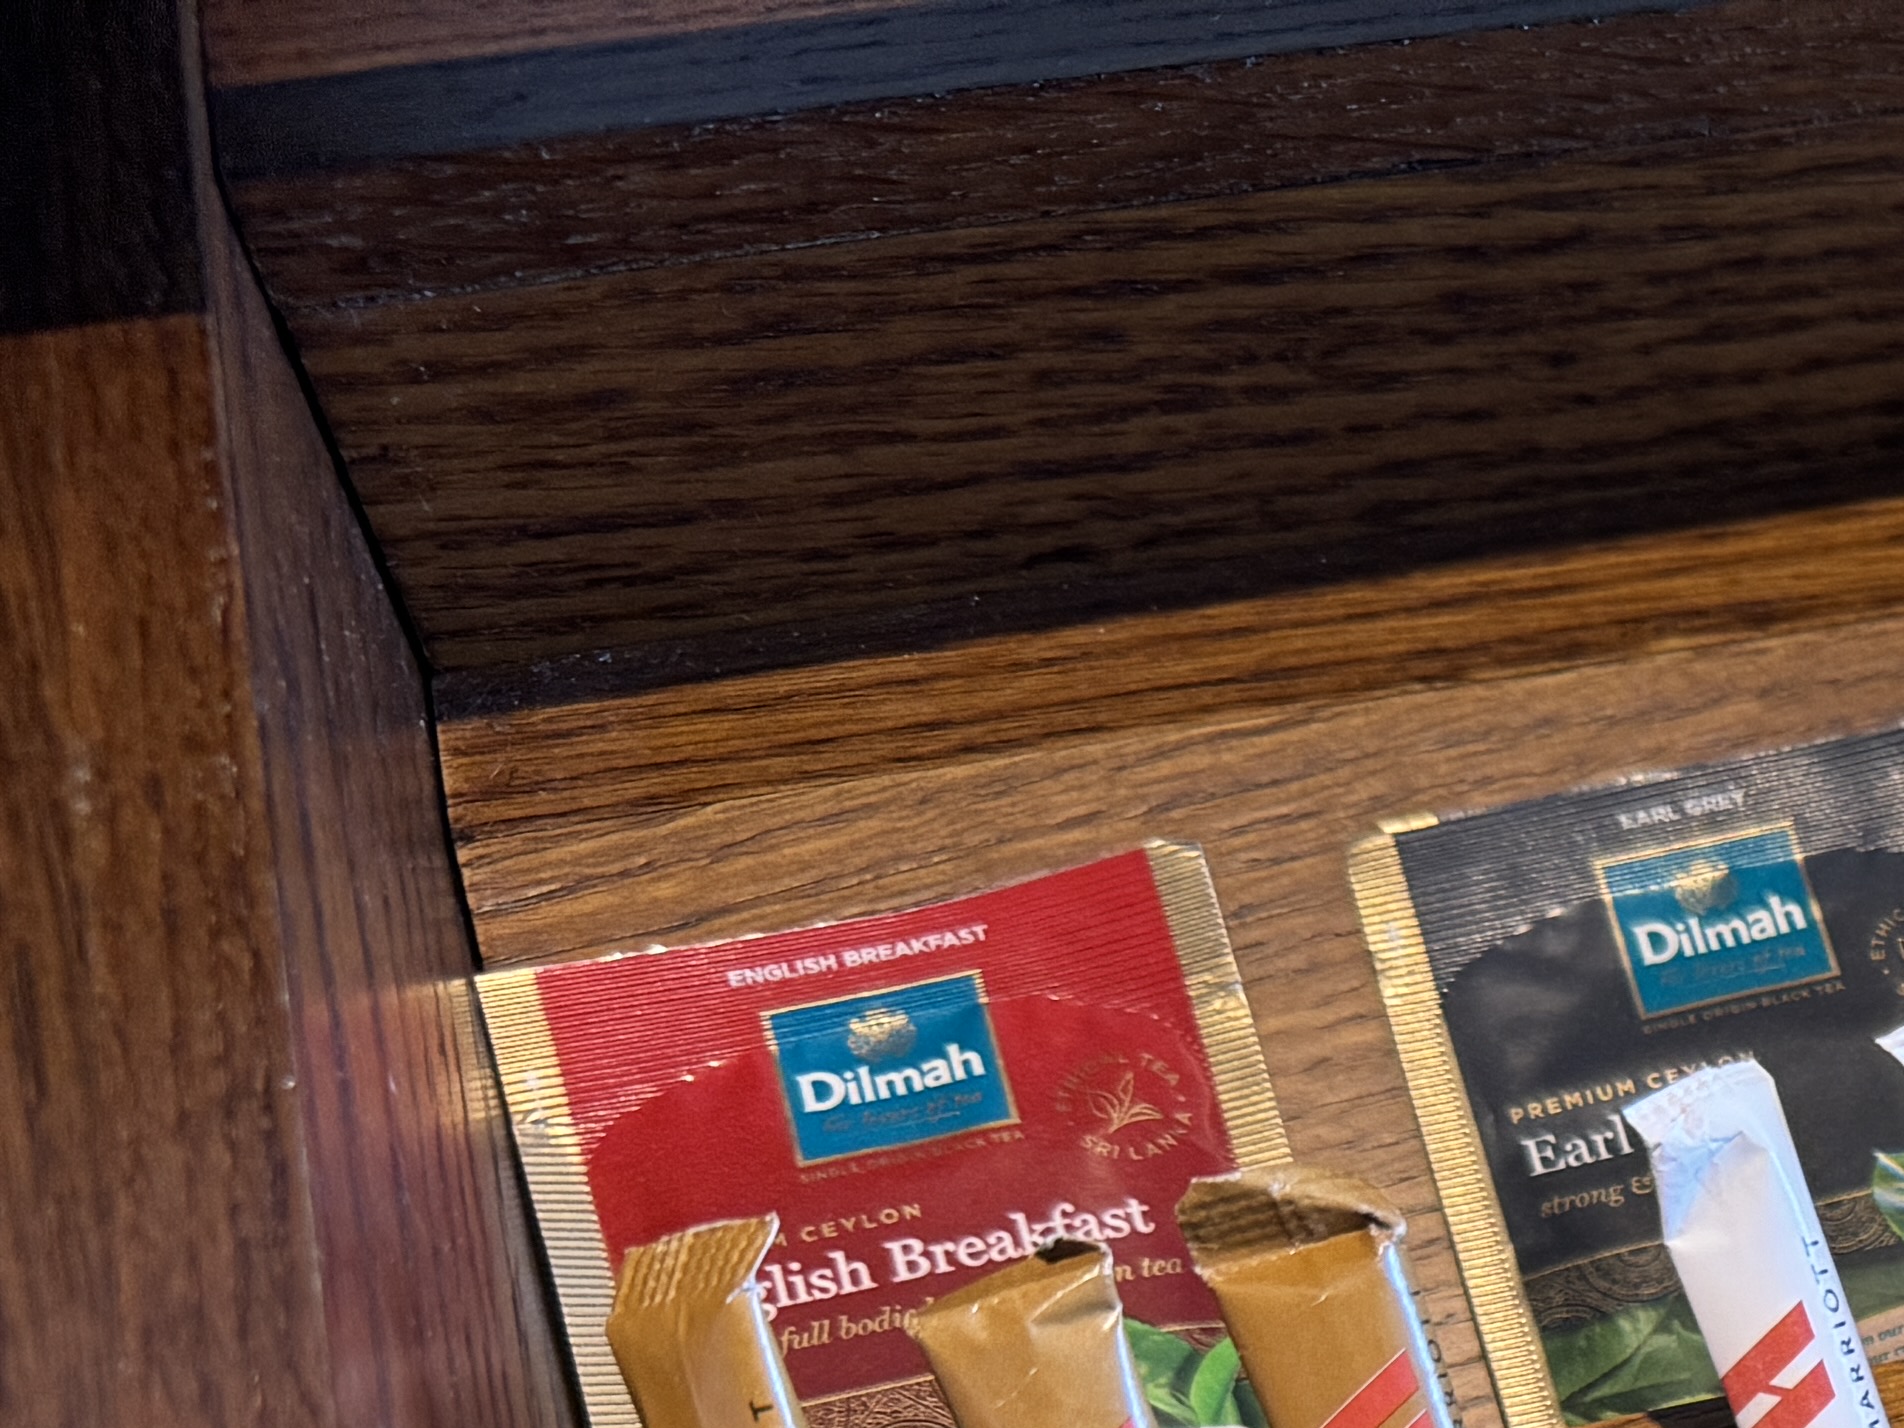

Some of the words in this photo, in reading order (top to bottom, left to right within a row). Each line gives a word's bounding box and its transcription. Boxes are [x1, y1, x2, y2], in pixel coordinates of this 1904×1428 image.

[1617, 801, 1680, 831] EARL
[1684, 791, 1746, 819] GREY
[1634, 894, 1808, 967] Dilmah
[726, 953, 839, 989] ENGLISH
[843, 924, 989, 969] BREAKFAST
[1815, 979, 1846, 998] TEA
[795, 1043, 986, 1114] Dilmah
[1140, 1052, 1181, 1088] TEA
[1509, 1078, 1636, 1125] PREMIUM
[1080, 1134, 1120, 1161] SRI
[1520, 1113, 1635, 1178] Earl
[1541, 1184, 1625, 1218] strong
[800, 1203, 923, 1244] CEYLON
[884, 1197, 1157, 1284] Breakfast
[1142, 1255, 1184, 1279] tea
[780, 1321, 832, 1356] full
